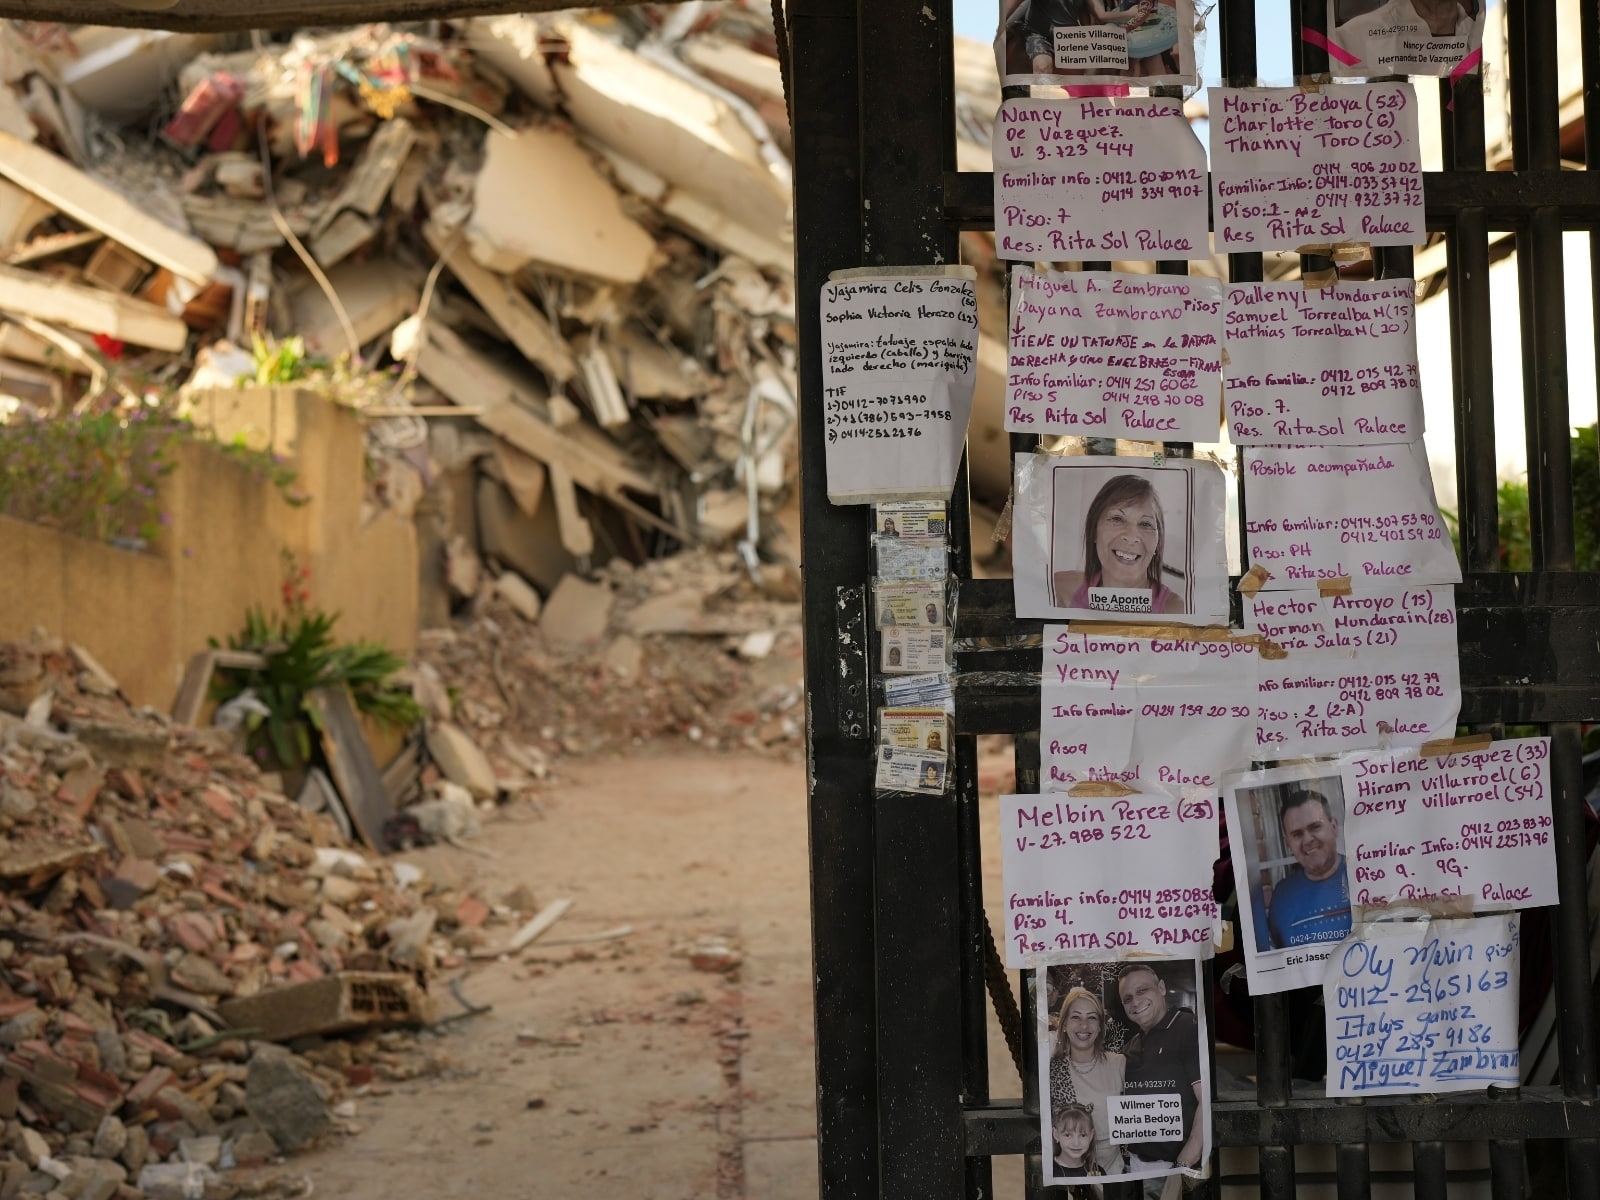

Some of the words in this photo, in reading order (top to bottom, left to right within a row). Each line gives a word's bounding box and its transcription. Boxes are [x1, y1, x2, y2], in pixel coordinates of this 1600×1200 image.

[1055, 30, 1086, 40] Oxenis
[1089, 30, 1125, 41] Villarroel
[1057, 43, 1089, 52] Jorlene
[1091, 43, 1126, 53] Vasquez
[1403, 41, 1424, 50] Nancy
[1426, 42, 1465, 50] Coromoto
[1060, 56, 1087, 64] Hiram
[1089, 56, 1126, 65] Villarroel
[1378, 55, 1417, 64] Hernandez
[1419, 55, 1427, 63] De
[1429, 54, 1463, 63] Vazquez
[1290, 93, 1361, 114] Bedoya
[1002, 107, 1061, 127] Nancy
[1081, 102, 1182, 120] Hernandez
[1224, 115, 1314, 133] Charlotte
[1006, 128, 1025, 141] De
[1225, 136, 1301, 157] Thanny
[1313, 163, 1340, 175] 0414
[1102, 187, 1133, 203] 0414
[1141, 187, 1163, 199] 334
[1058, 208, 1071, 224] 7
[1362, 215, 1415, 234] Palace
[1135, 229, 1192, 251] Palace
[894, 281, 923, 293] Celis
[1112, 280, 1190, 296] Zambrano
[826, 310, 862, 323] Sophia
[868, 306, 911, 319] Victoria
[918, 305, 954, 320] Herazo
[958, 311, 978, 329] (12)
[1095, 303, 1182, 320] Zambrano
[1226, 308, 1288, 324] Samuel
[1298, 307, 1371, 321] Torrealba
[1226, 325, 1285, 339] Mathias
[876, 334, 915, 349] tatuaje
[831, 366, 854, 374] lado
[863, 359, 906, 371] derecho
[1321, 370, 1353, 383] 0412
[1322, 386, 1355, 396] 0412
[1122, 409, 1180, 430] Palace
[1354, 416, 1407, 434] Palace
[1250, 460, 1297, 476] Posible
[1362, 561, 1412, 576] Palace
[1091, 594, 1107, 603] Ibe
[1111, 595, 1149, 606] Aponte
[1253, 598, 1317, 617] Hector
[1333, 595, 1394, 611] Arroyo
[1053, 633, 1140, 654] Salomon
[1314, 633, 1362, 648] Salas
[1057, 664, 1119, 690] Yenny
[1340, 690, 1371, 701] 0412
[1352, 756, 1429, 778] Jorlene
[1158, 766, 1215, 786] Palace
[1358, 781, 1410, 797] Hiram
[1017, 803, 1105, 828] Melbin
[1111, 800, 1170, 821] Perez
[1353, 798, 1406, 816] Oxeny
[1482, 883, 1533, 901] Palace
[1151, 928, 1210, 944] PALACE
[1287, 956, 1303, 965] Eric
[1340, 1048, 1425, 1090] Miguel
[1120, 1101, 1155, 1109] Wilmer
[1158, 1100, 1179, 1108] Toro
[1115, 1115, 1142, 1124] Maria
[1144, 1114, 1180, 1124] Bedoya
[1112, 1130, 1157, 1138] Charlotte
